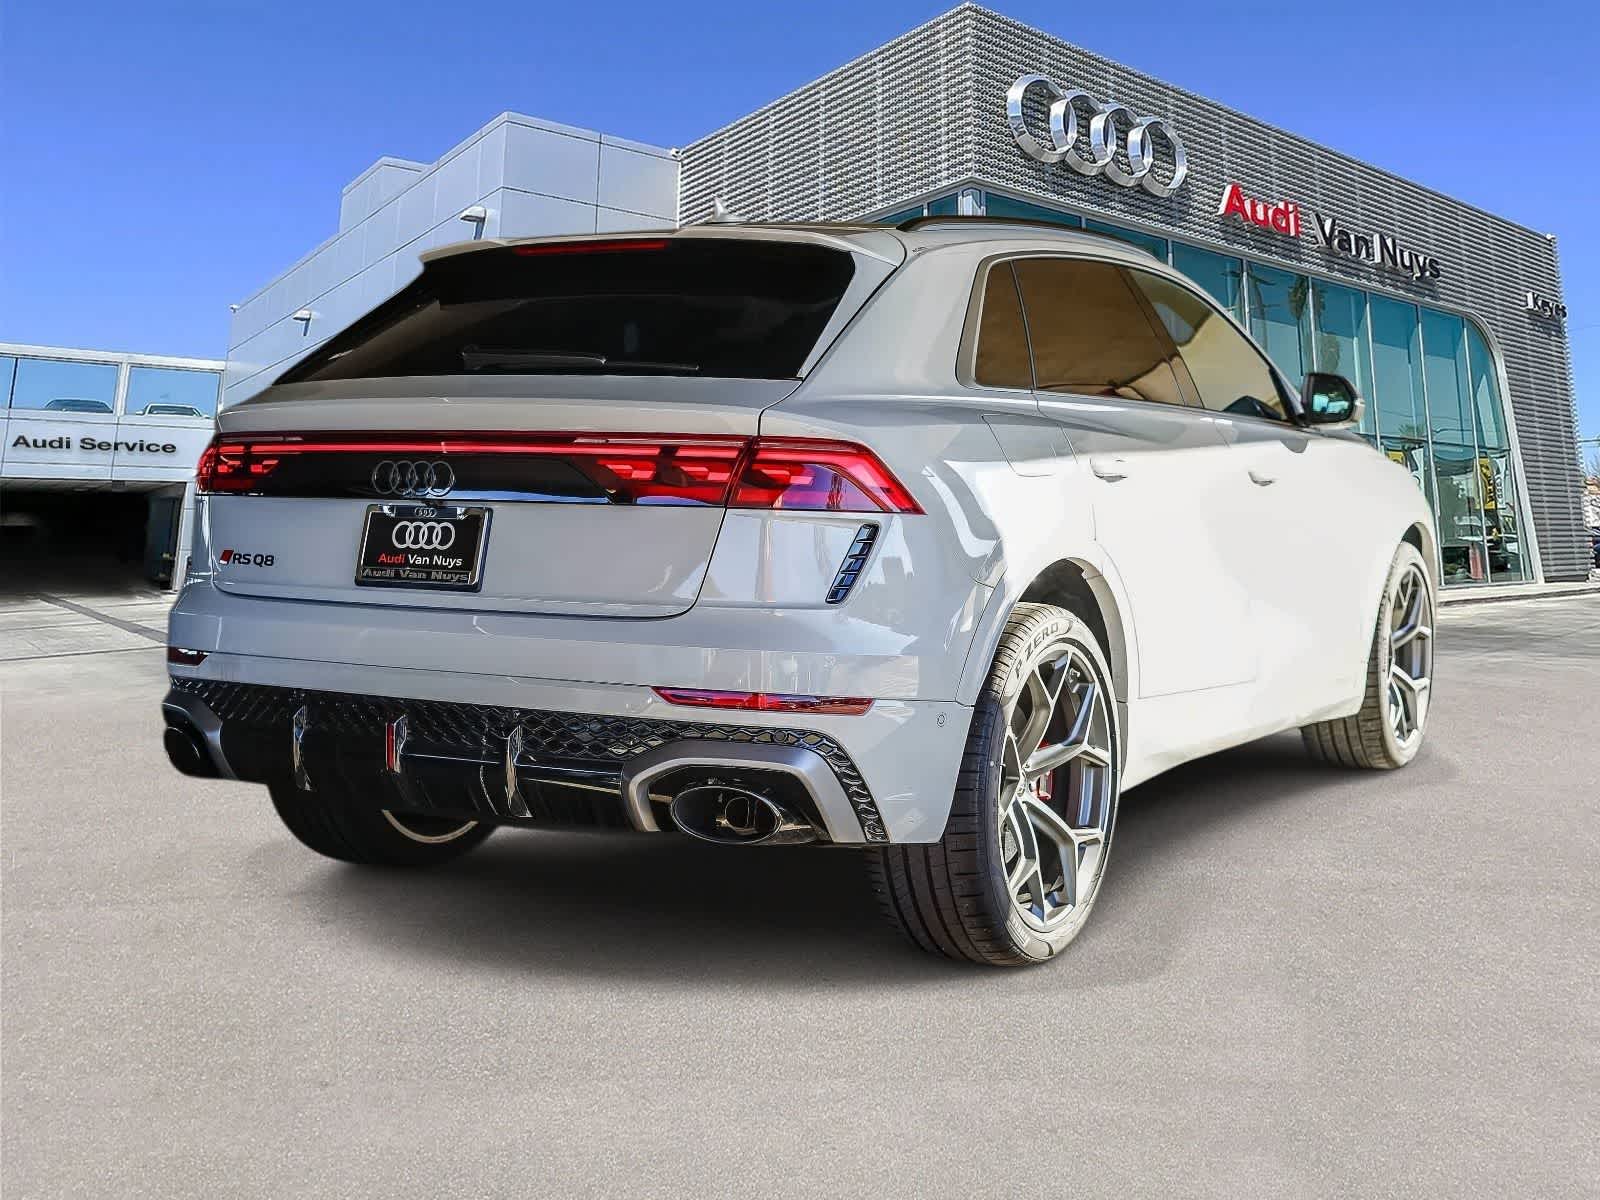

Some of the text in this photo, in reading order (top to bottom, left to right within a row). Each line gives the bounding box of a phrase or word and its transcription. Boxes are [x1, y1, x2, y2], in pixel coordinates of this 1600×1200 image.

[1218, 183, 1442, 281] Audi Van Nuys
[1527, 291, 1567, 318] Keyes
[12, 435, 177, 453] Audi Service
[232, 553, 275, 567] RS Q8
[378, 553, 463, 568] Audi Van Nuys
[361, 568, 468, 582] Audi Van Nuys
